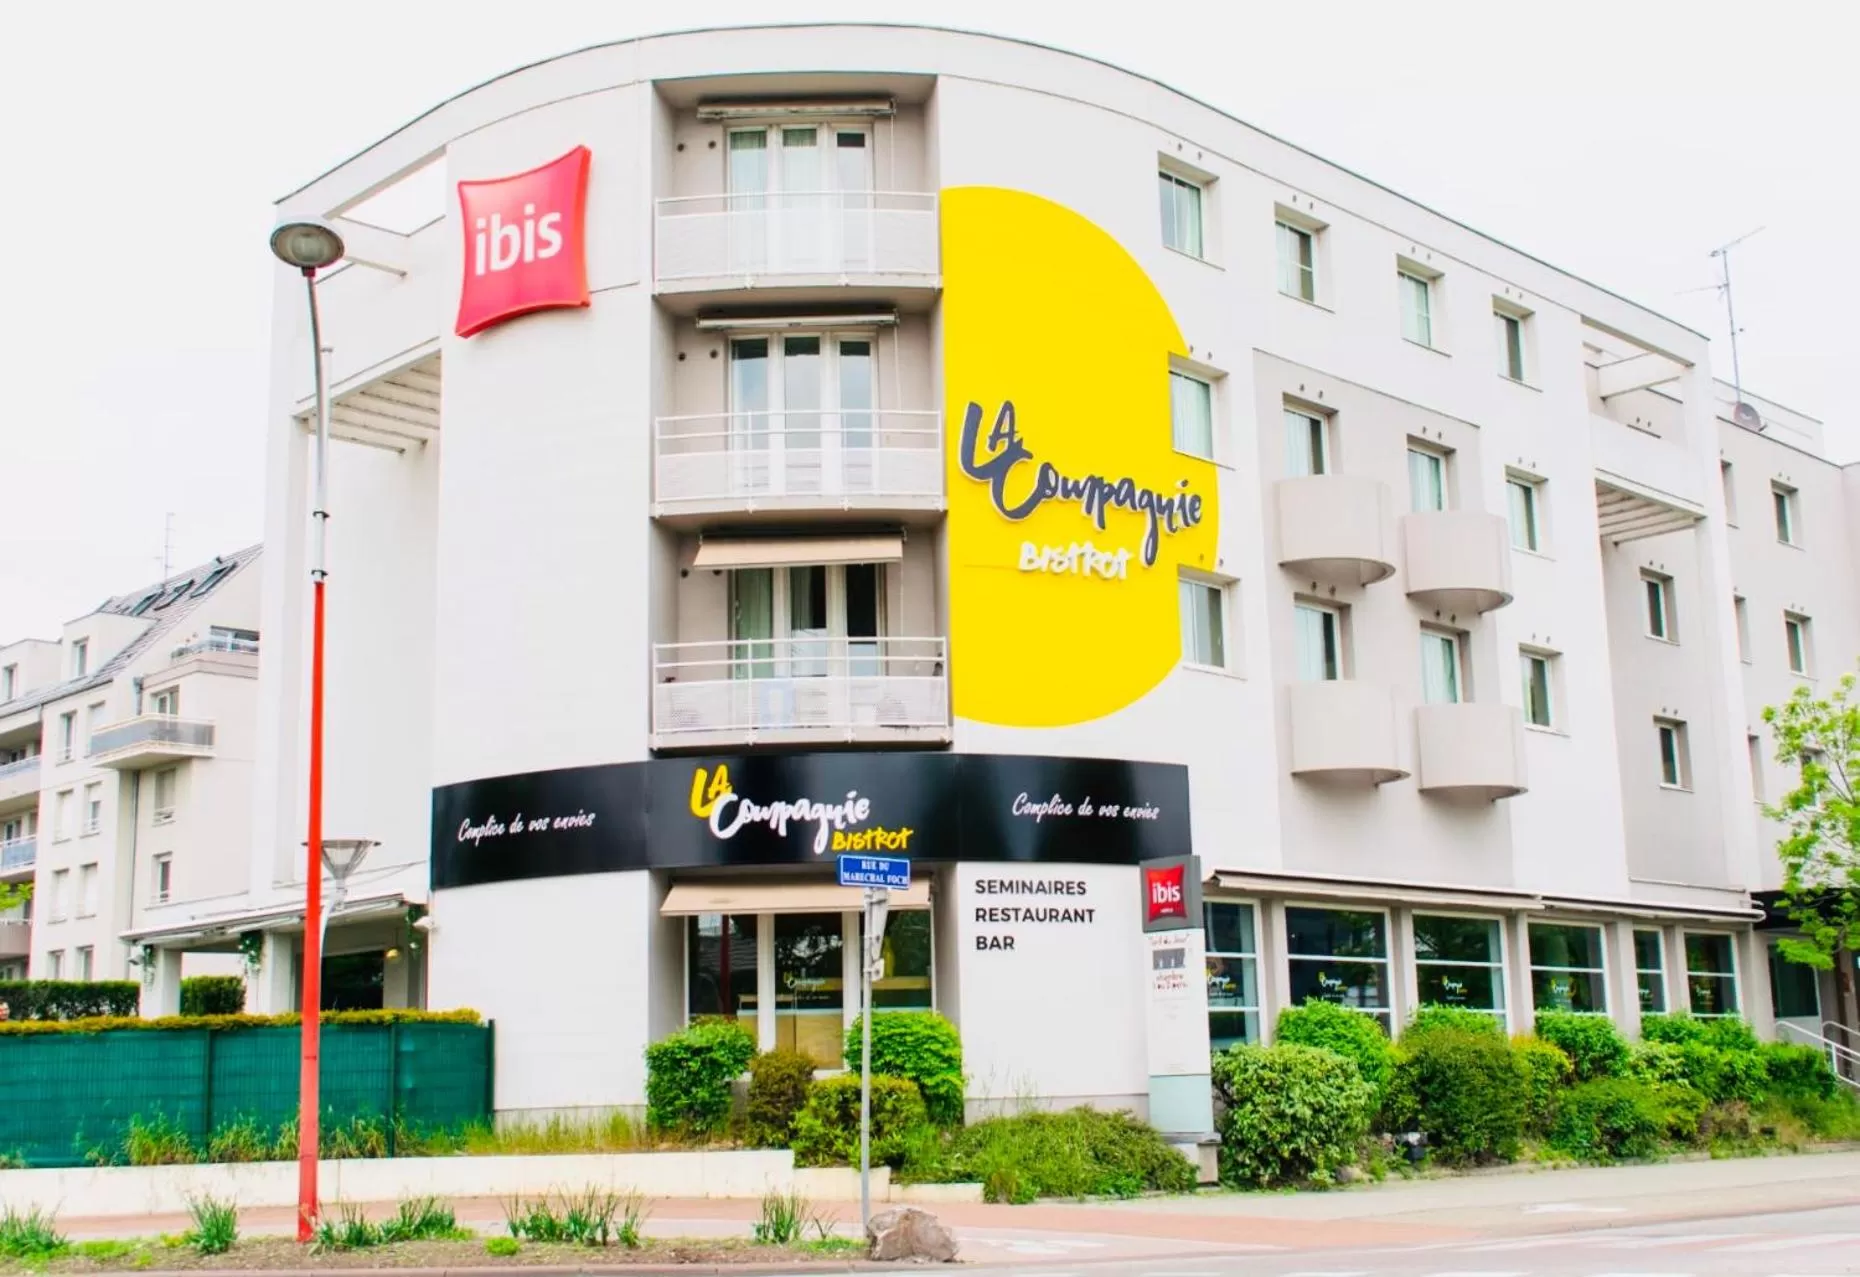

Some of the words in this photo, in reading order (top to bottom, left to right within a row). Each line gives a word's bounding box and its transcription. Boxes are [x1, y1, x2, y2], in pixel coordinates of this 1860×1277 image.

[475, 203, 563, 276] ibis
[960, 400, 1023, 481] LA
[991, 440, 1202, 567] Compagnie
[690, 764, 732, 817] LA
[1012, 792, 1073, 824] Complice
[1078, 796, 1093, 816] de
[1098, 804, 1120, 817] vos
[1123, 802, 1160, 820] envies
[458, 814, 506, 847] Complice
[509, 813, 524, 834] de
[528, 816, 550, 831] vos
[553, 808, 596, 830] envies
[709, 791, 870, 854] Compagnie
[831, 826, 913, 850] BISTROT
[861, 860, 877, 870] RUE
[879, 862, 890, 871] DU
[887, 875, 908, 884] FOCH
[975, 880, 1087, 895] SEMINAIRES
[1152, 880, 1181, 904] ibis
[975, 907, 1095, 923] RESTAURANT
[976, 935, 1015, 950] BAR
